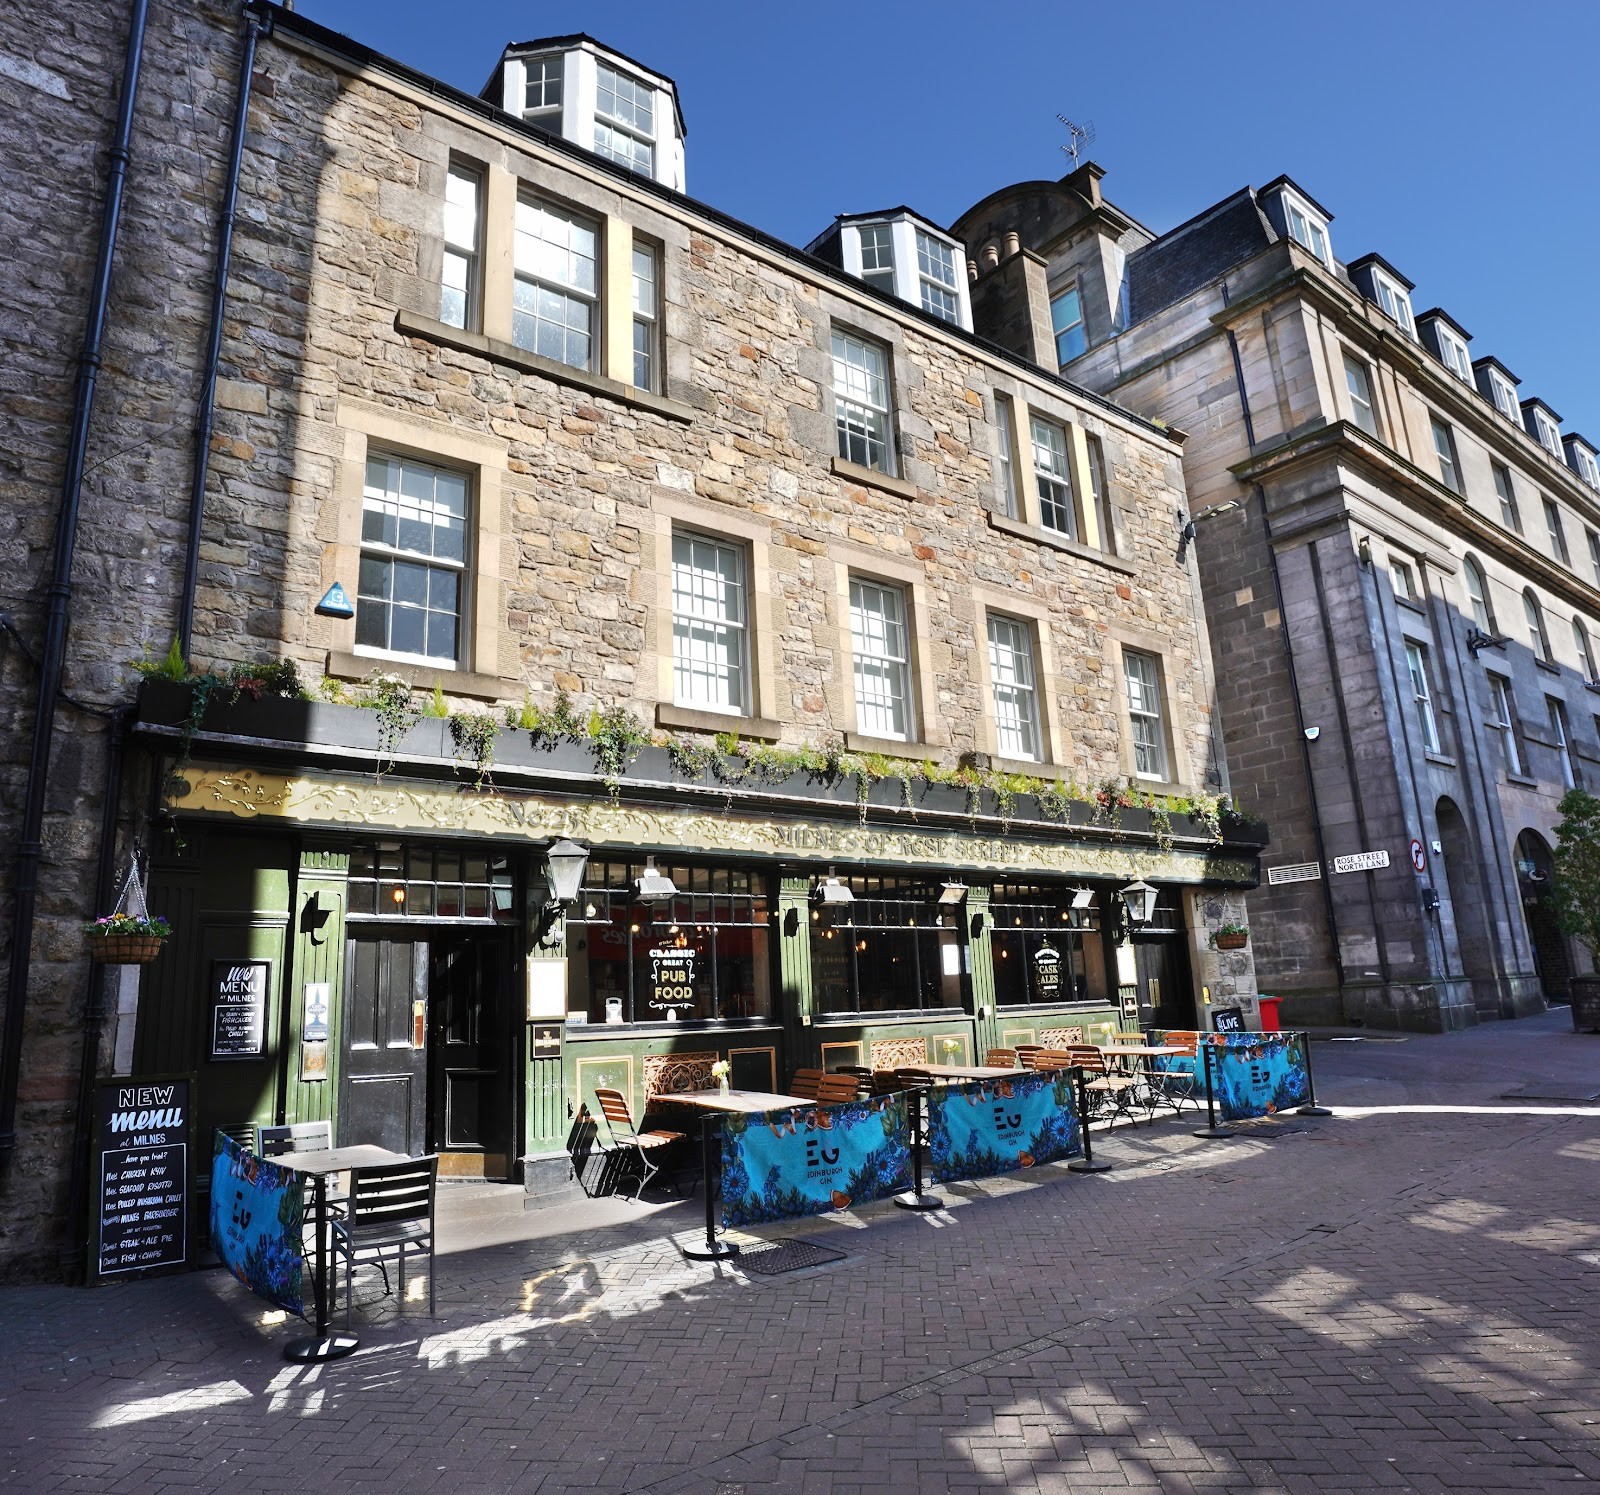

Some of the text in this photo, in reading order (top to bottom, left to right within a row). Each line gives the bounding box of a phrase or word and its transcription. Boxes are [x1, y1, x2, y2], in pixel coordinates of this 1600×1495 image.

[897, 835, 947, 858] ROSE
[953, 839, 1025, 863] STREET
[1336, 852, 1386, 865] ROSE STREET
[1338, 859, 1387, 871] NORTH LANE
[649, 949, 696, 958] CLASSIC
[1039, 964, 1058, 974] CASK
[661, 970, 686, 982] PUB
[1040, 975, 1058, 984] ALES
[220, 981, 260, 993] MENU
[654, 986, 693, 999] FOOD
[227, 994, 256, 1003] MILNES
[1222, 1016, 1239, 1030] LIVE
[118, 1085, 175, 1108] NEW
[106, 1108, 183, 1132] menu
[993, 1106, 1022, 1131] EG
[133, 1133, 166, 1146] MILNES
[997, 1130, 1025, 1140] EDINBURGH
[806, 1139, 840, 1167] EG
[140, 1155, 150, 1165] you
[120, 1168, 147, 1180] CHICKEN
[807, 1167, 843, 1179] EDINBURGH
[119, 1183, 145, 1194] SEAFOOD
[147, 1180, 173, 1191] RISOTTO
[819, 1177, 832, 1185] GIN
[117, 1198, 136, 1209] PULLED
[120, 1239, 140, 1249] STEAK
[145, 1235, 158, 1246] ALE
[161, 1234, 173, 1243] PIE
[121, 1253, 137, 1263] FISH
[141, 1249, 162, 1260] CHIPS
